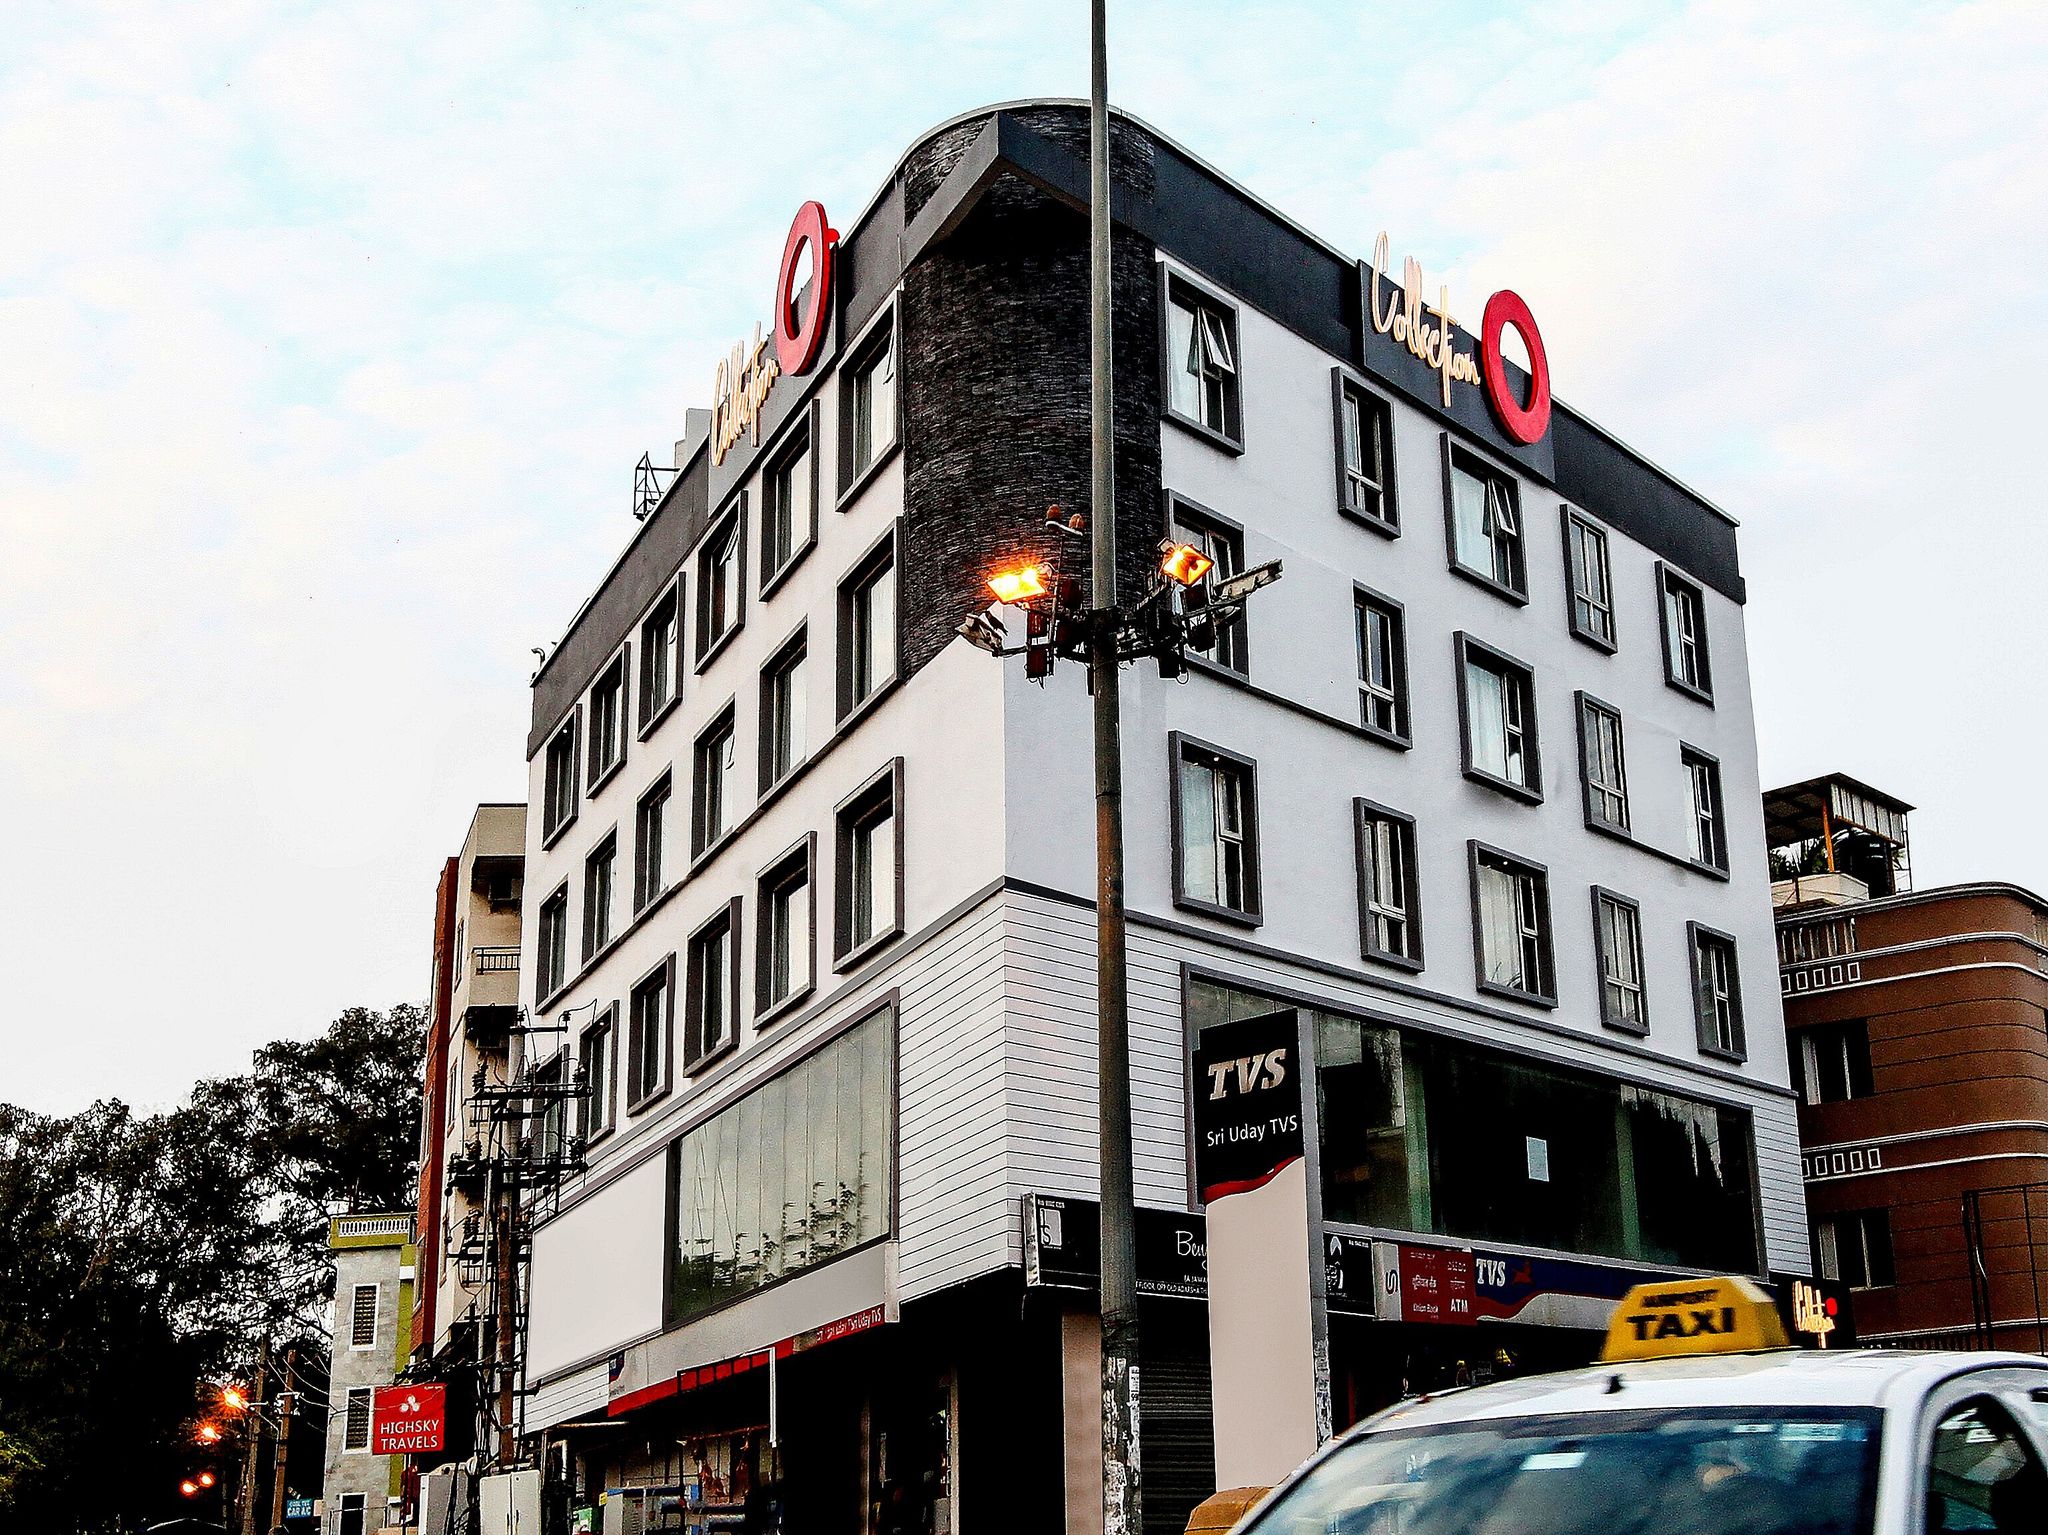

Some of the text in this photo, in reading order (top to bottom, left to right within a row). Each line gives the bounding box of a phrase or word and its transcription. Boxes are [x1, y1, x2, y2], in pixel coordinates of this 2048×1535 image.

[1371, 231, 1481, 408] Collection
[1208, 1049, 1287, 1100] TVS
[1207, 1115, 1298, 1147] Sri Uday TVS
[1475, 1258, 1506, 1288] TVS
[1450, 1298, 1469, 1313] ATM
[1627, 1307, 1736, 1341] TAXI
[380, 1419, 440, 1435] HIGHSKY
[380, 1435, 438, 1451] TRAVELS
